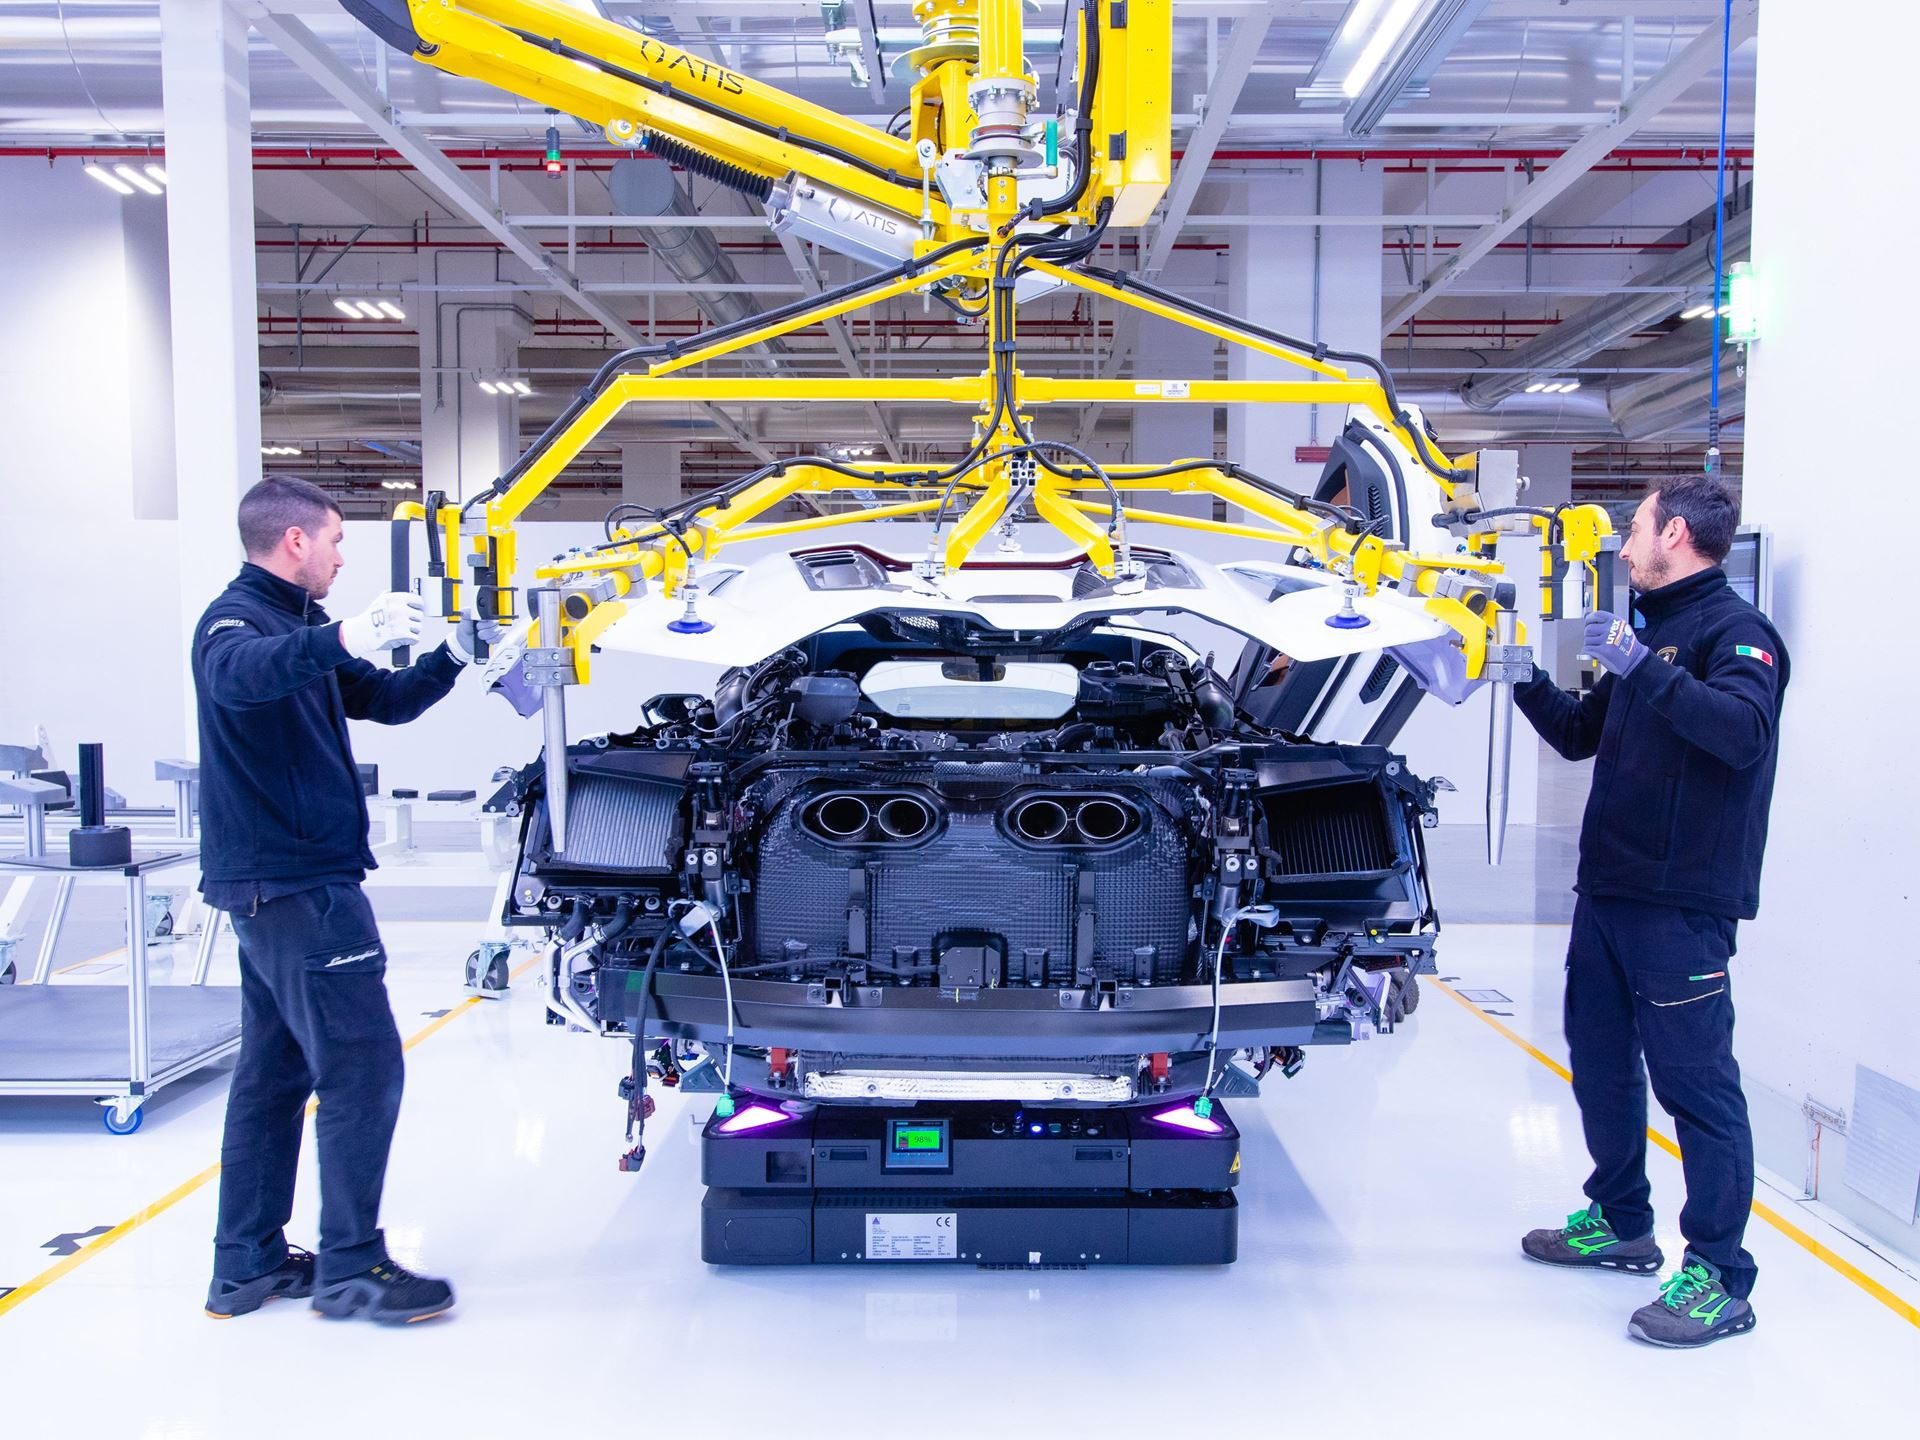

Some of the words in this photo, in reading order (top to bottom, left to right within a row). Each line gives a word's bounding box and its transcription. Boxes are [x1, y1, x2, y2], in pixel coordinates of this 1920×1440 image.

[668, 55, 745, 95] ATIS
[854, 210, 898, 235] ATIS
[1606, 619, 1621, 645] uvex
[935, 1216, 951, 1228] CE
